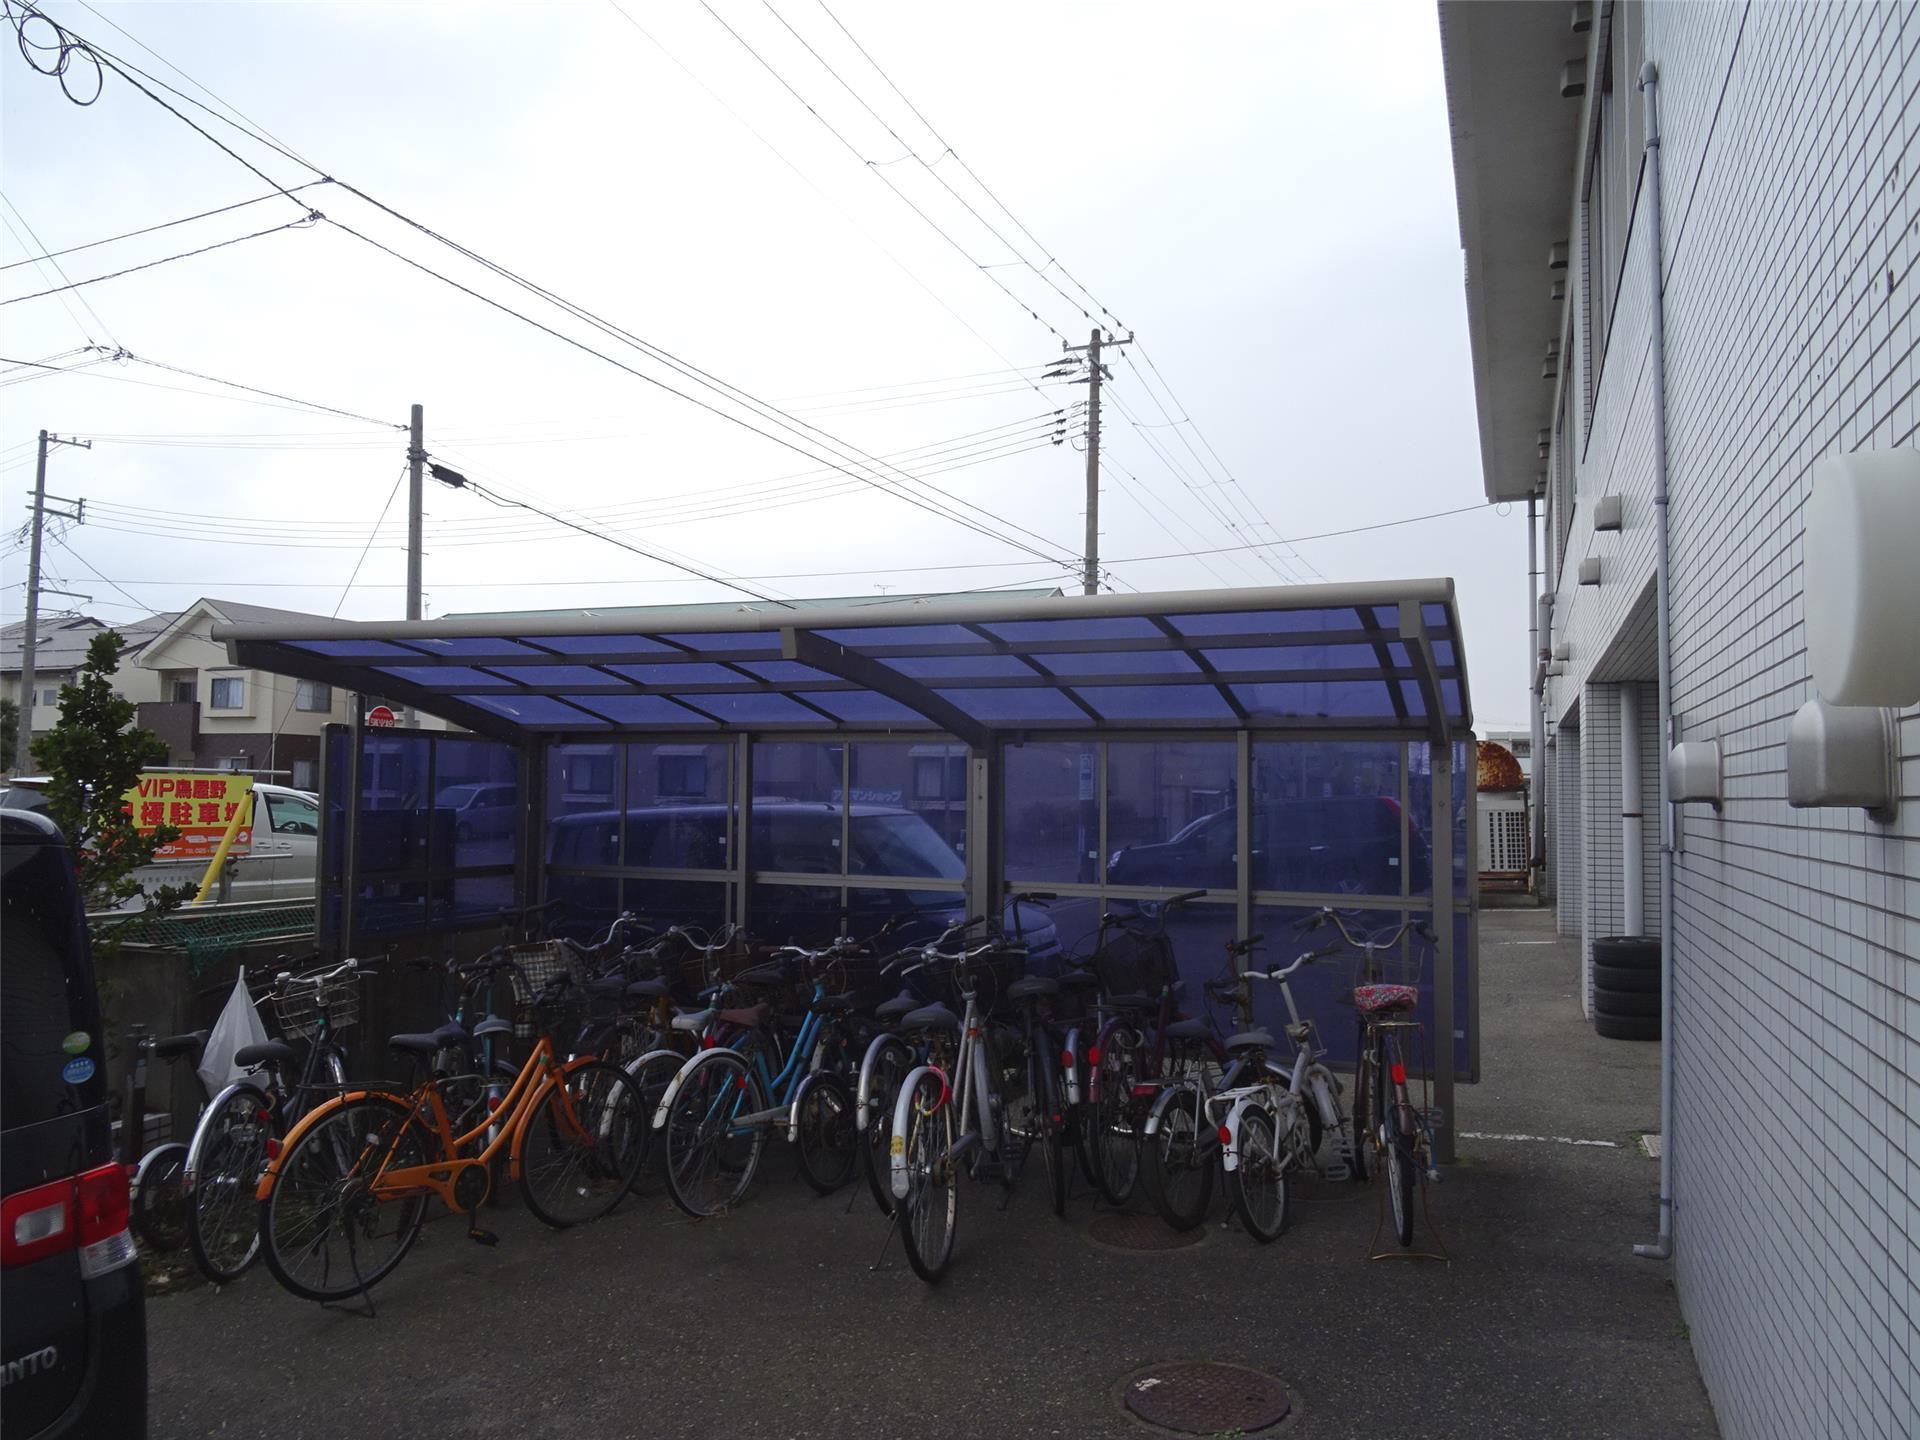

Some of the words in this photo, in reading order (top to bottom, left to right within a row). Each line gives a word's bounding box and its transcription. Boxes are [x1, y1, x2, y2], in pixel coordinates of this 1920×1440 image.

[833, 790, 902, 802] アマンショップ
